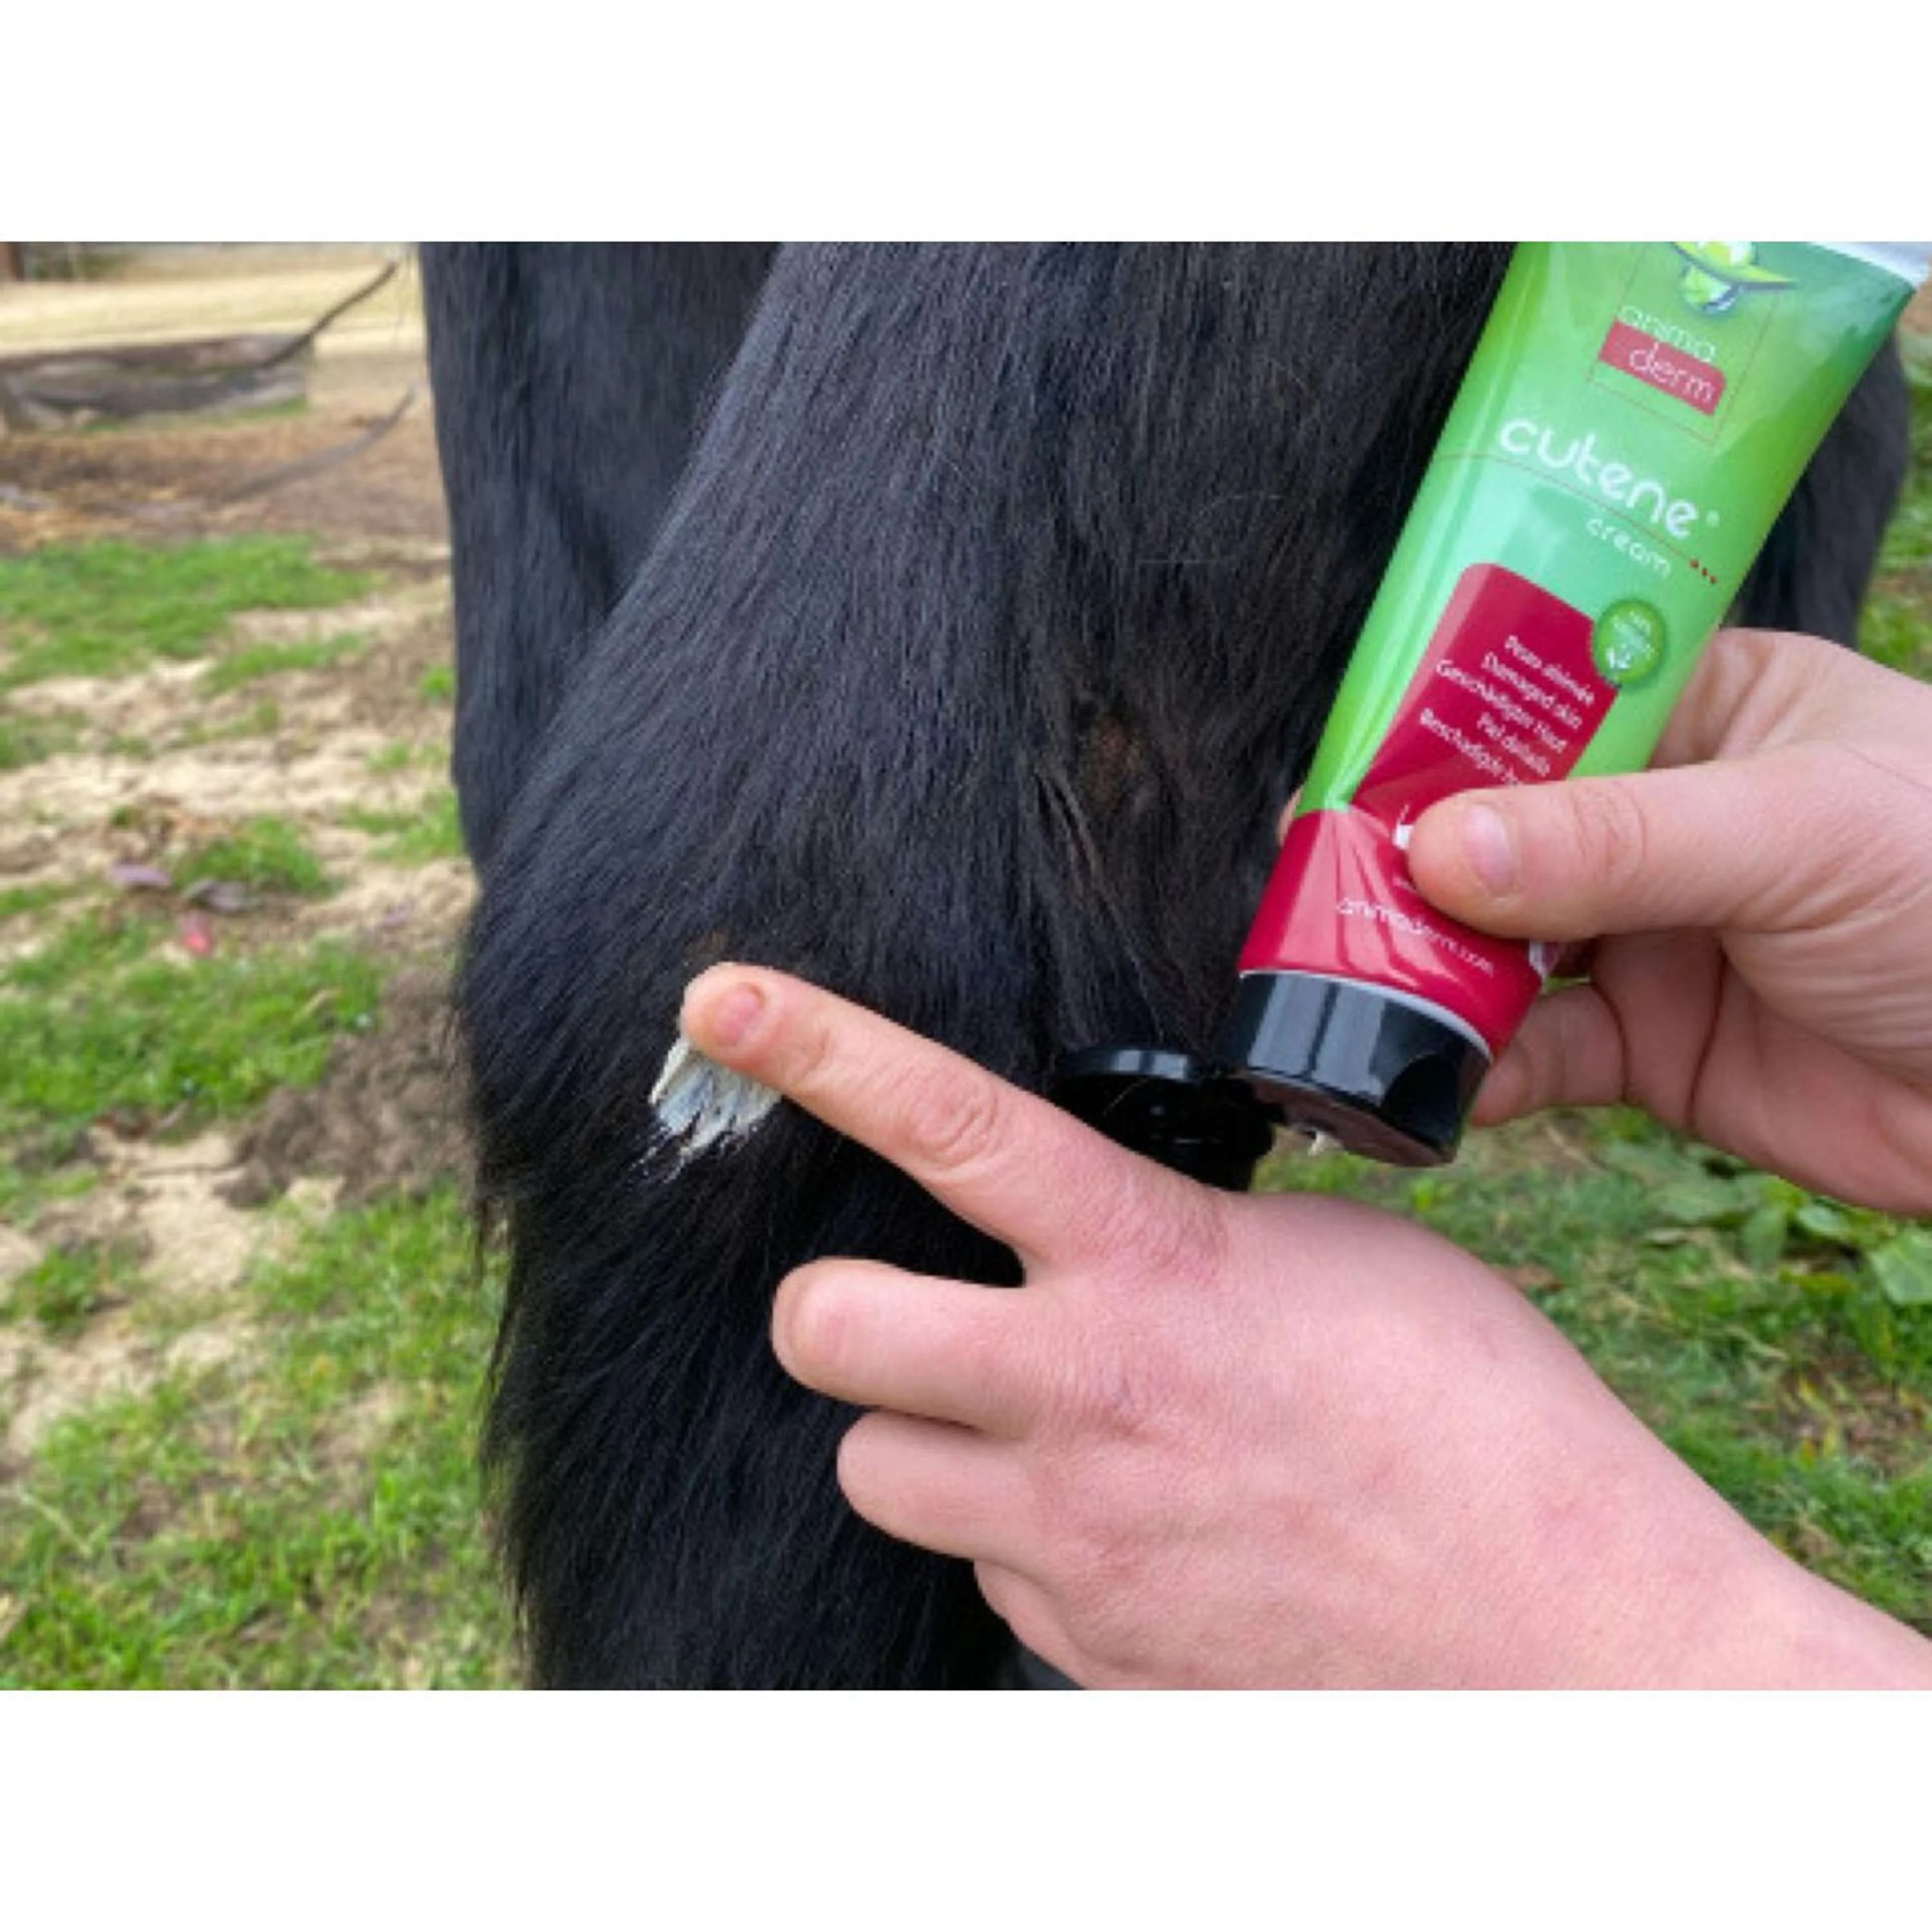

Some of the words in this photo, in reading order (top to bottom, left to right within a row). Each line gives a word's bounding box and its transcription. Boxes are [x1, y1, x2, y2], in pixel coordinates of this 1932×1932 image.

[1629, 342, 1713, 404] derm
[1499, 418, 1699, 538] cutene
[1586, 517, 1671, 579] cream
[1481, 651, 1555, 710] Damaged
[1553, 704, 1582, 730] skin
